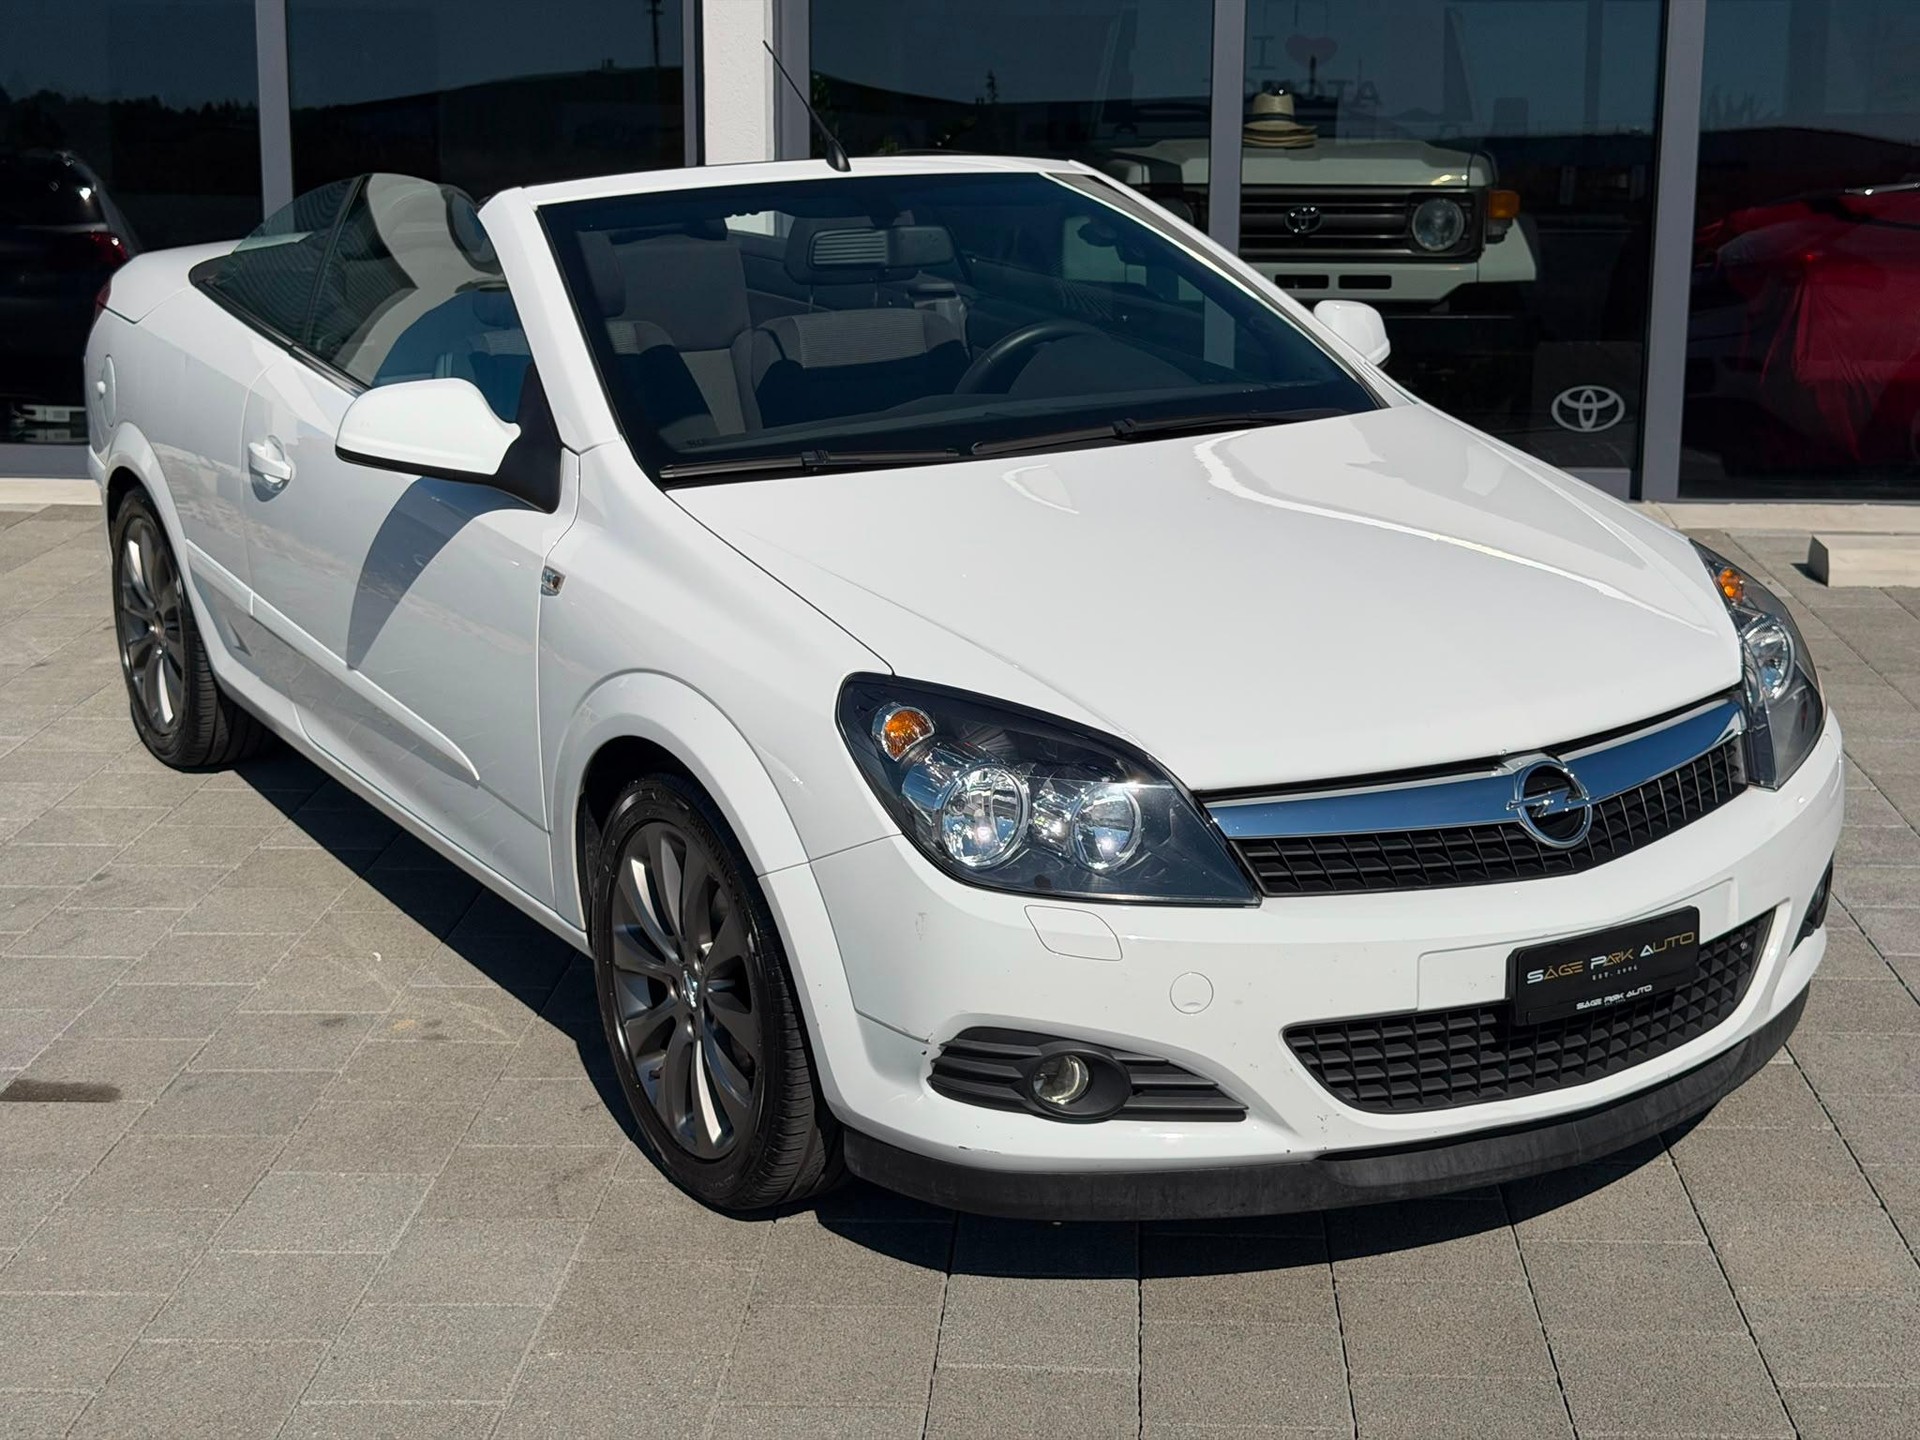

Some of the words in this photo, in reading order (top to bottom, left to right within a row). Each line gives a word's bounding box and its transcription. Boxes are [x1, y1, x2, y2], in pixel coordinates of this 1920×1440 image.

[1590, 947, 1635, 971] PARK
[1639, 931, 1695, 958] AUTO
[1626, 984, 1653, 998] AUTO
